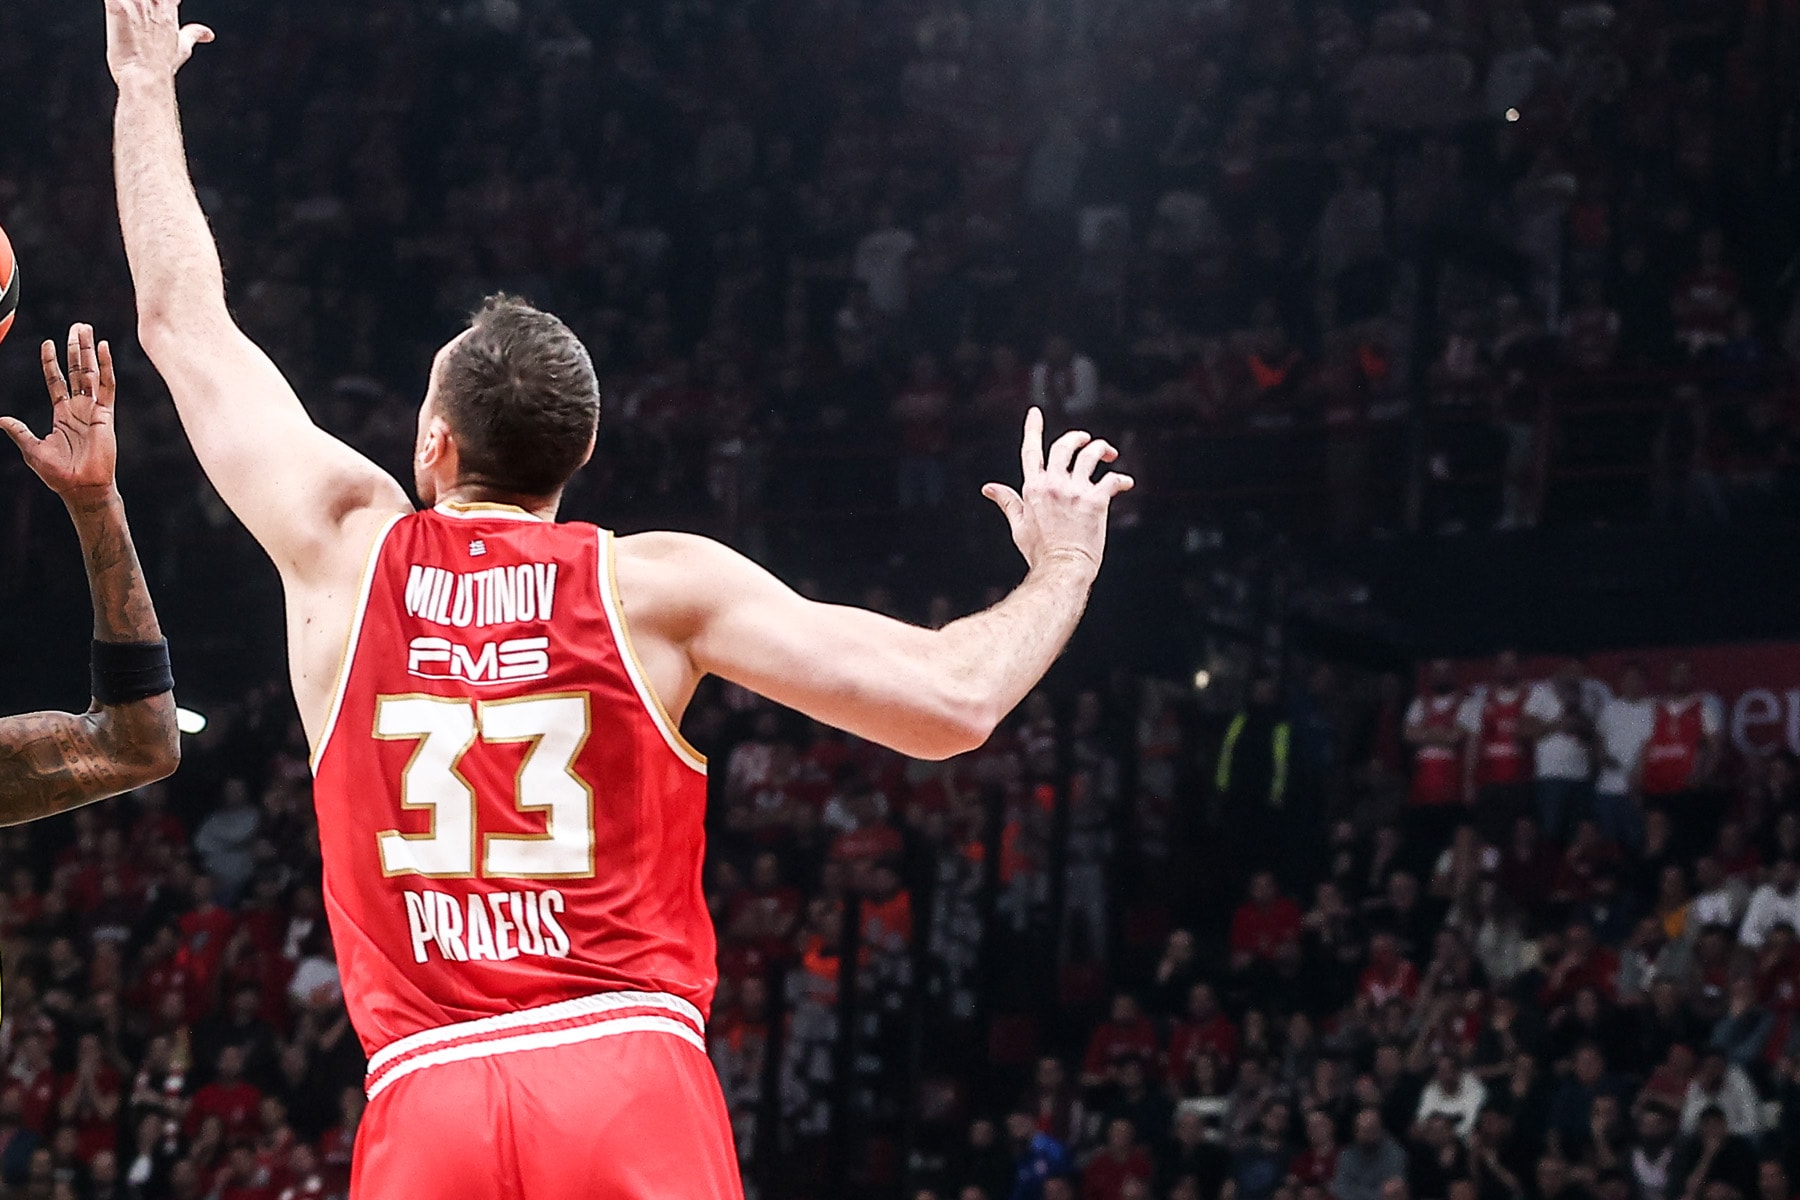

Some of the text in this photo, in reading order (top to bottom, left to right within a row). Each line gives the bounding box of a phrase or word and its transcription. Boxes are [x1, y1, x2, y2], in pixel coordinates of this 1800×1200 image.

[405, 562, 558, 628] MILUTINOV
[371, 690, 596, 879] 33
[403, 889, 571, 964] PIRAEUS
